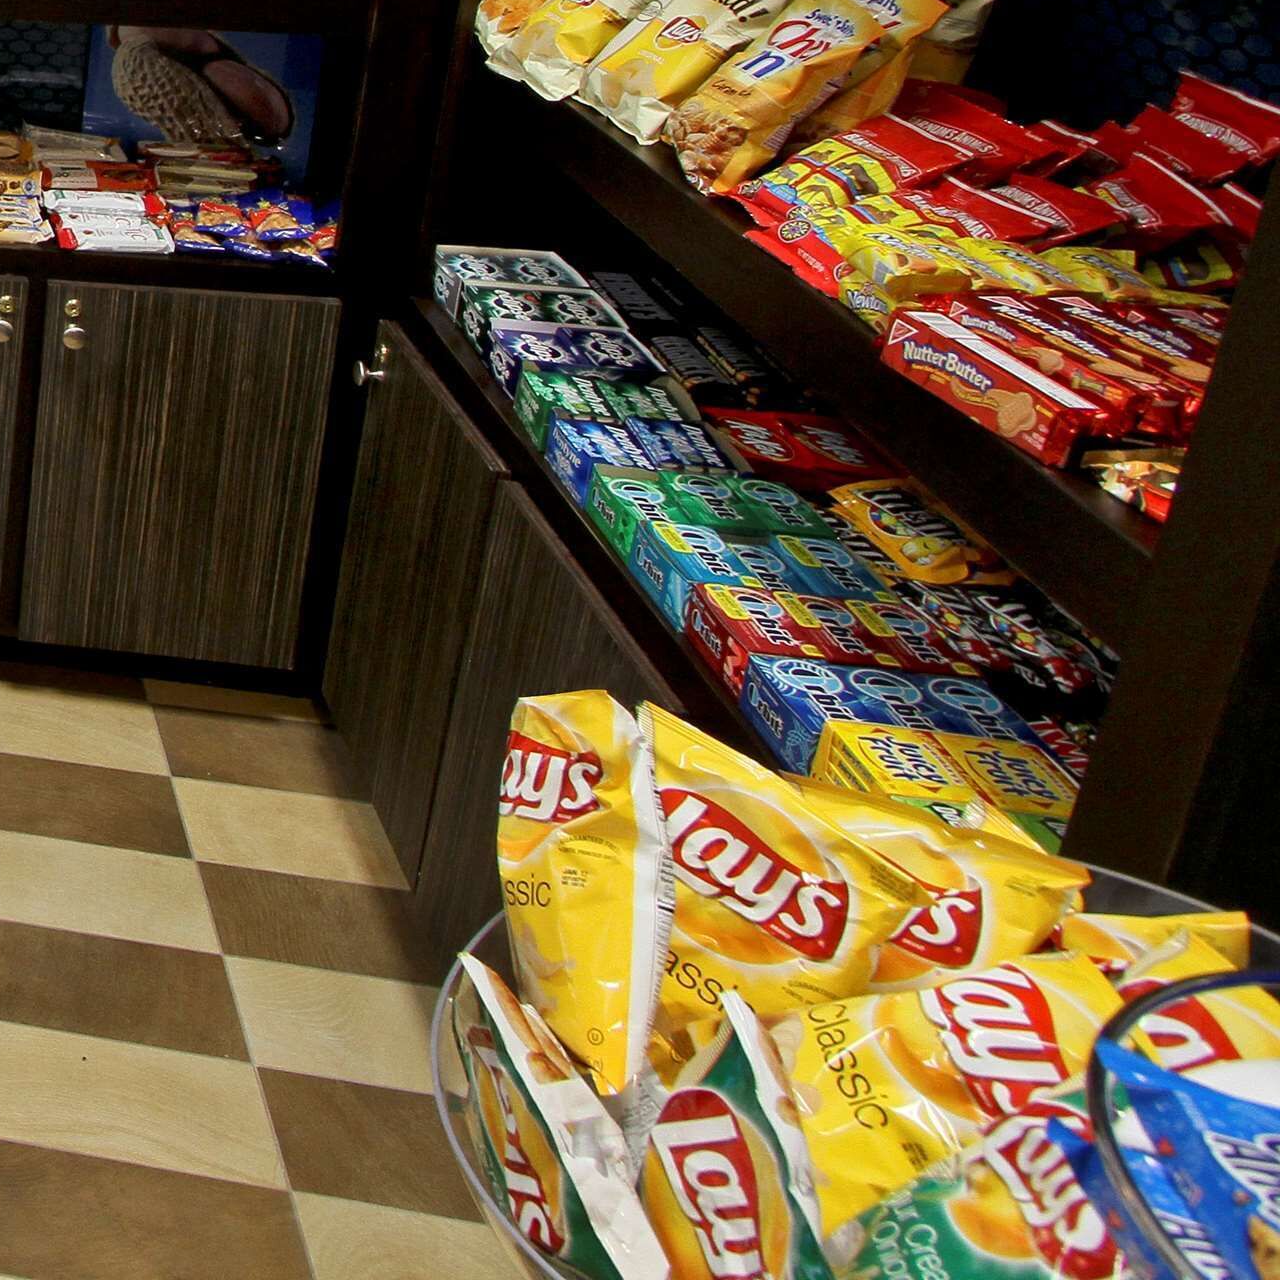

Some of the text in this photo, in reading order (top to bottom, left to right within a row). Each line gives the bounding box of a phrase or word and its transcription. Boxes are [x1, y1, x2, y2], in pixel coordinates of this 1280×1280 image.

[903, 341, 992, 391] Nutter Butter
[571, 376, 611, 417] Dentyne
[605, 424, 656, 470] Dentyne
[680, 423, 726, 468] Dentyne
[675, 473, 744, 521] Orbit
[742, 479, 812, 528] Orbit
[677, 524, 733, 578] Orbit
[690, 608, 724, 660] Orbit
[730, 586, 797, 648] Orbit
[802, 595, 867, 656] Orbit
[874, 604, 941, 664] Orbit
[747, 678, 783, 740] Orbit
[499, 748, 601, 822] ay's
[858, 735, 948, 786] Juicy Fruit
[963, 748, 1057, 800] Juicy Fruit
[504, 874, 552, 908] ssic
[664, 793, 842, 940] Lay's
[808, 1002, 889, 1131] Classic
[652, 1114, 765, 1280] Lay
